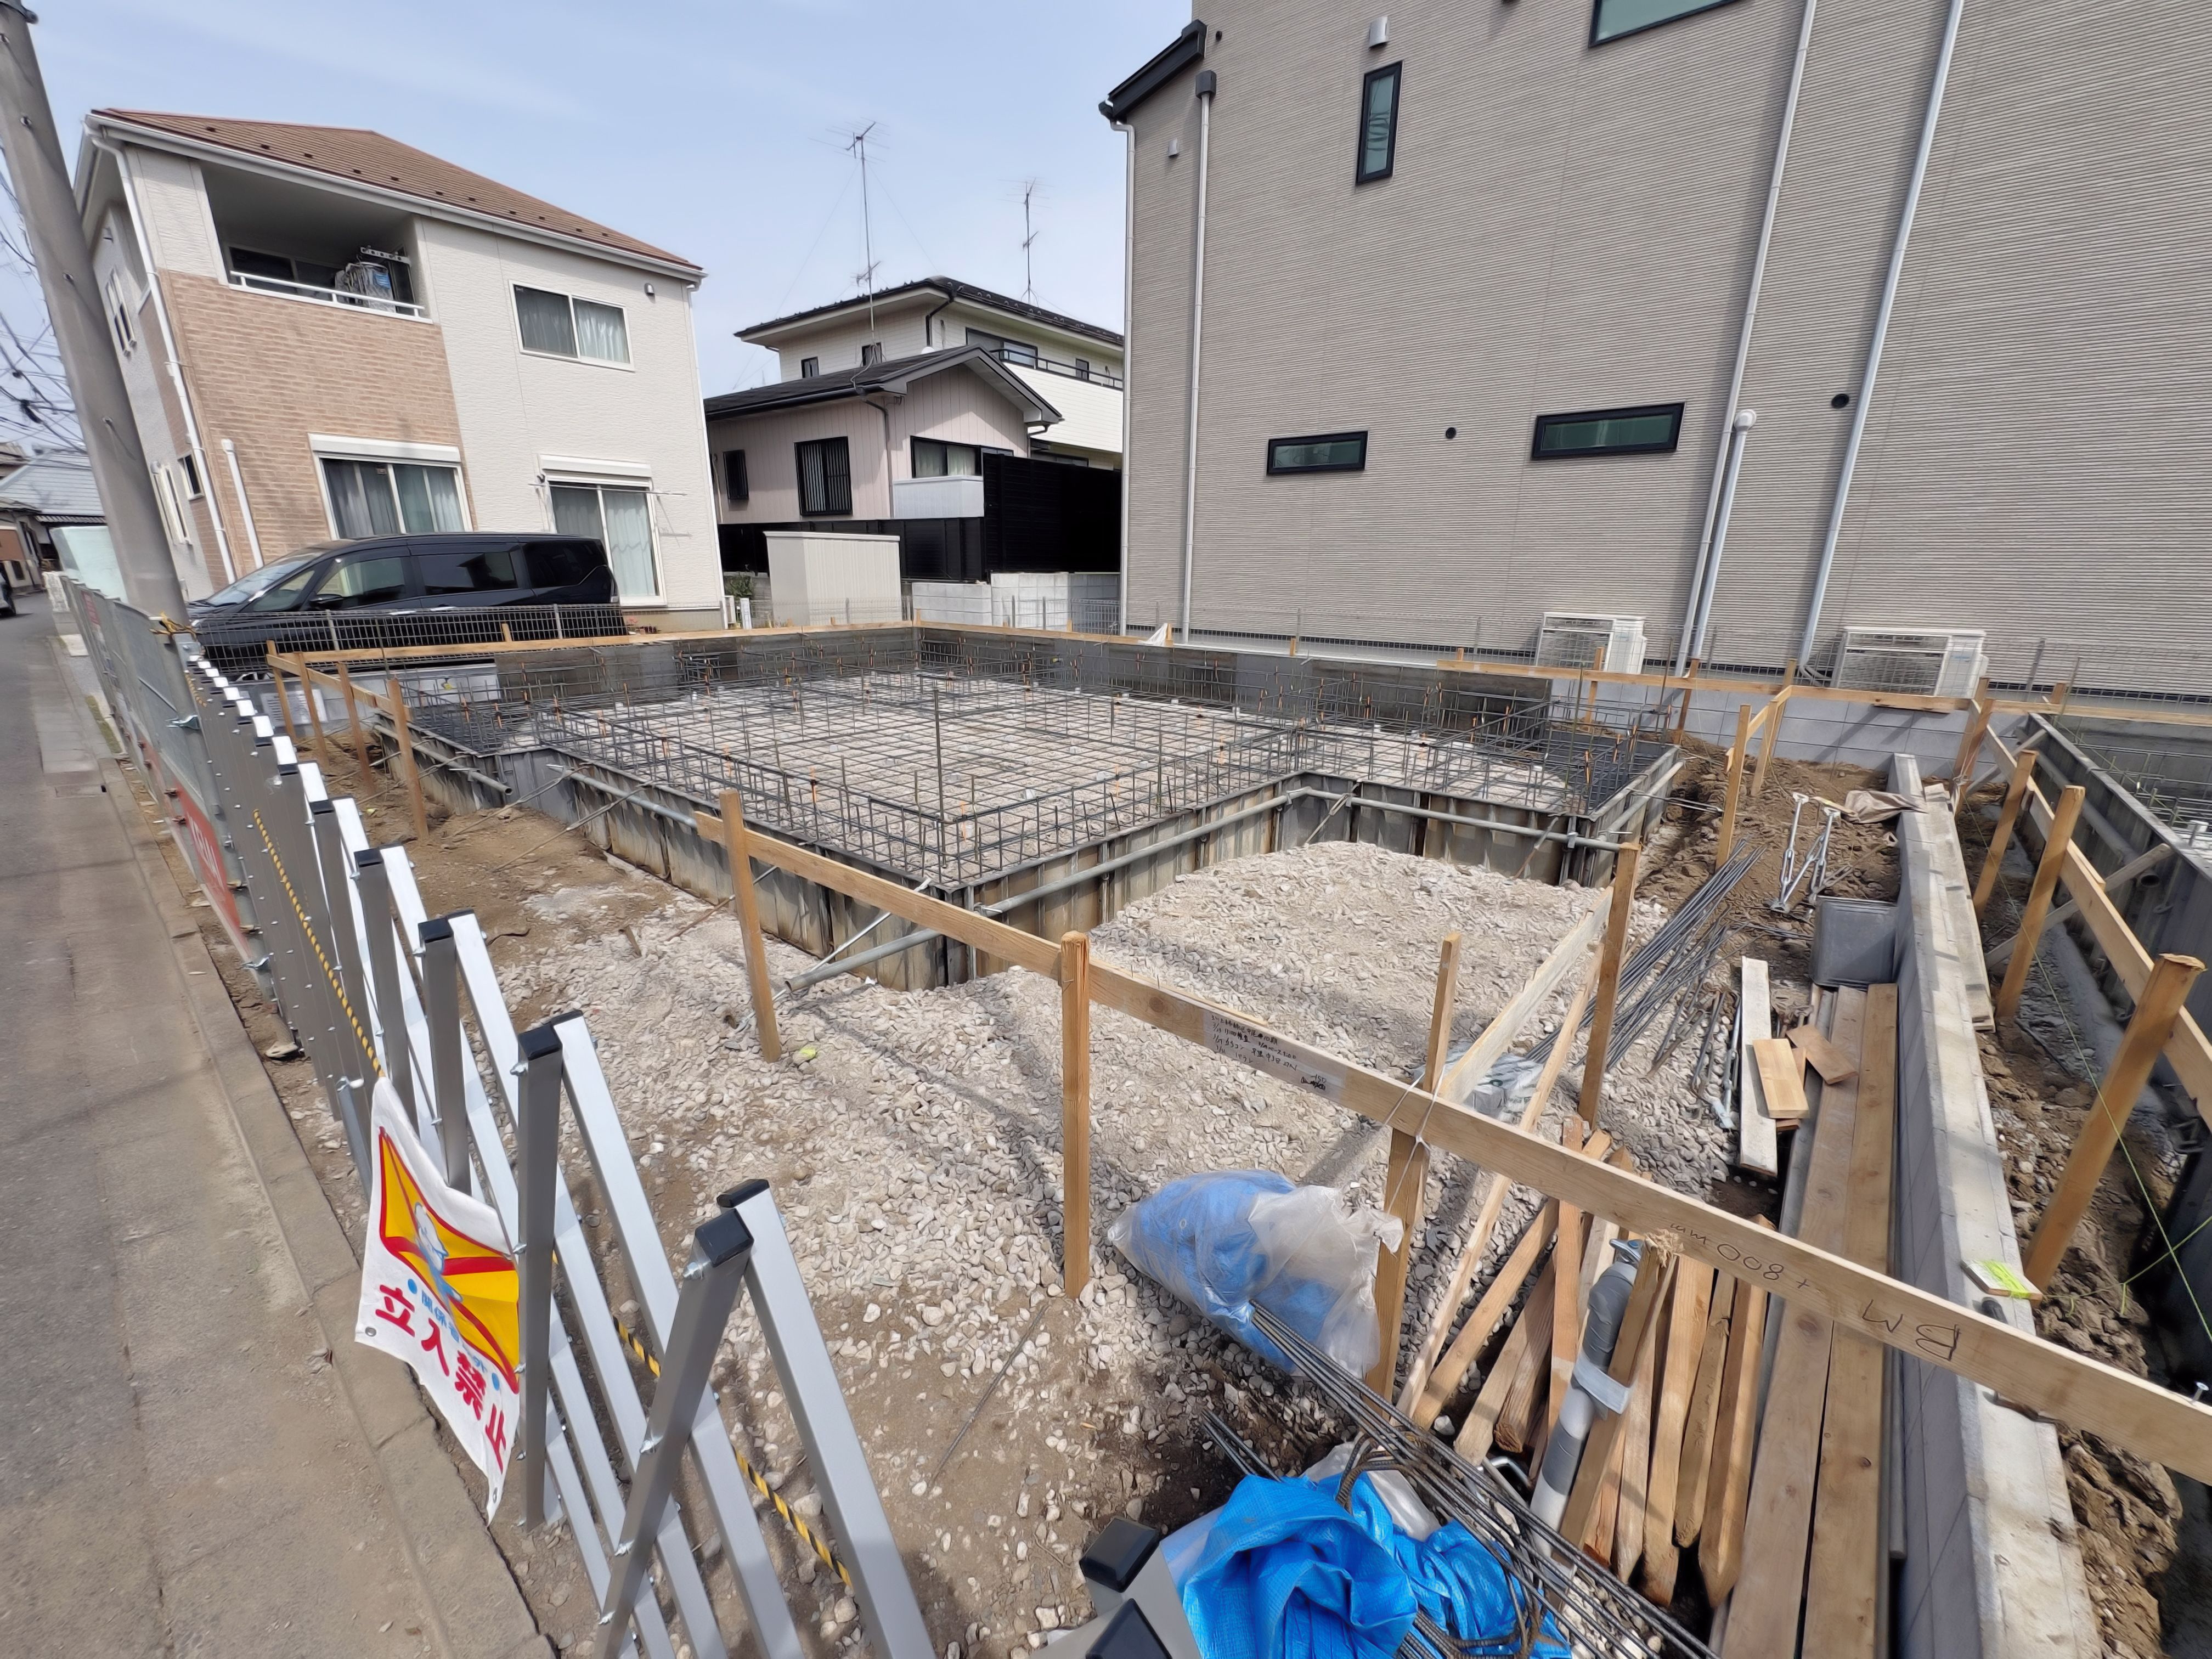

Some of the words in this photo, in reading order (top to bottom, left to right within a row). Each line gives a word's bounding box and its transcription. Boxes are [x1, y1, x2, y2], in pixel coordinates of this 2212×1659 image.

[375, 1284, 506, 1473] 立入禁止
[1861, 1299, 1961, 1361] BM
